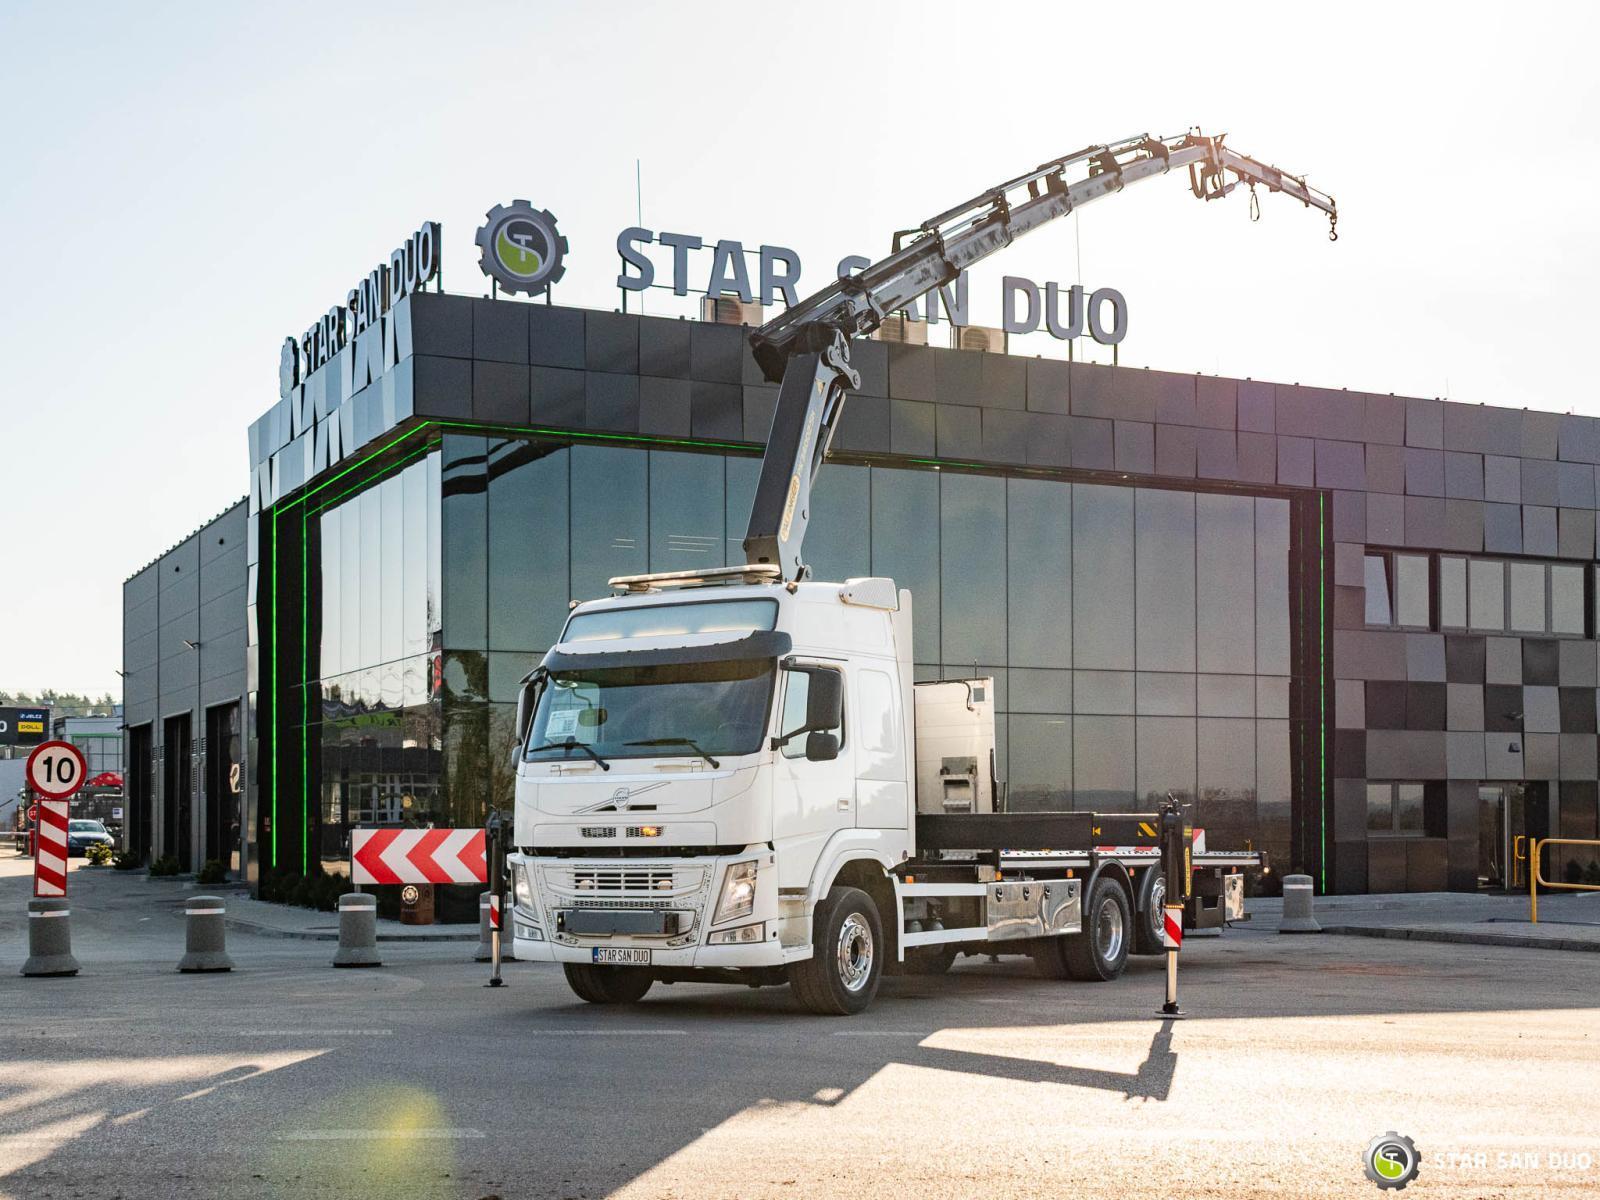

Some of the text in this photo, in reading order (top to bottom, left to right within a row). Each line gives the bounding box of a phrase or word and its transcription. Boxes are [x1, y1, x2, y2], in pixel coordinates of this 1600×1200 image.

[300, 221, 438, 380] STAR SAN DUO
[616, 226, 802, 310] STAR
[1002, 275, 1128, 345] DUO
[43, 756, 75, 784] 10
[598, 949, 649, 962] STAR SAN DUO
